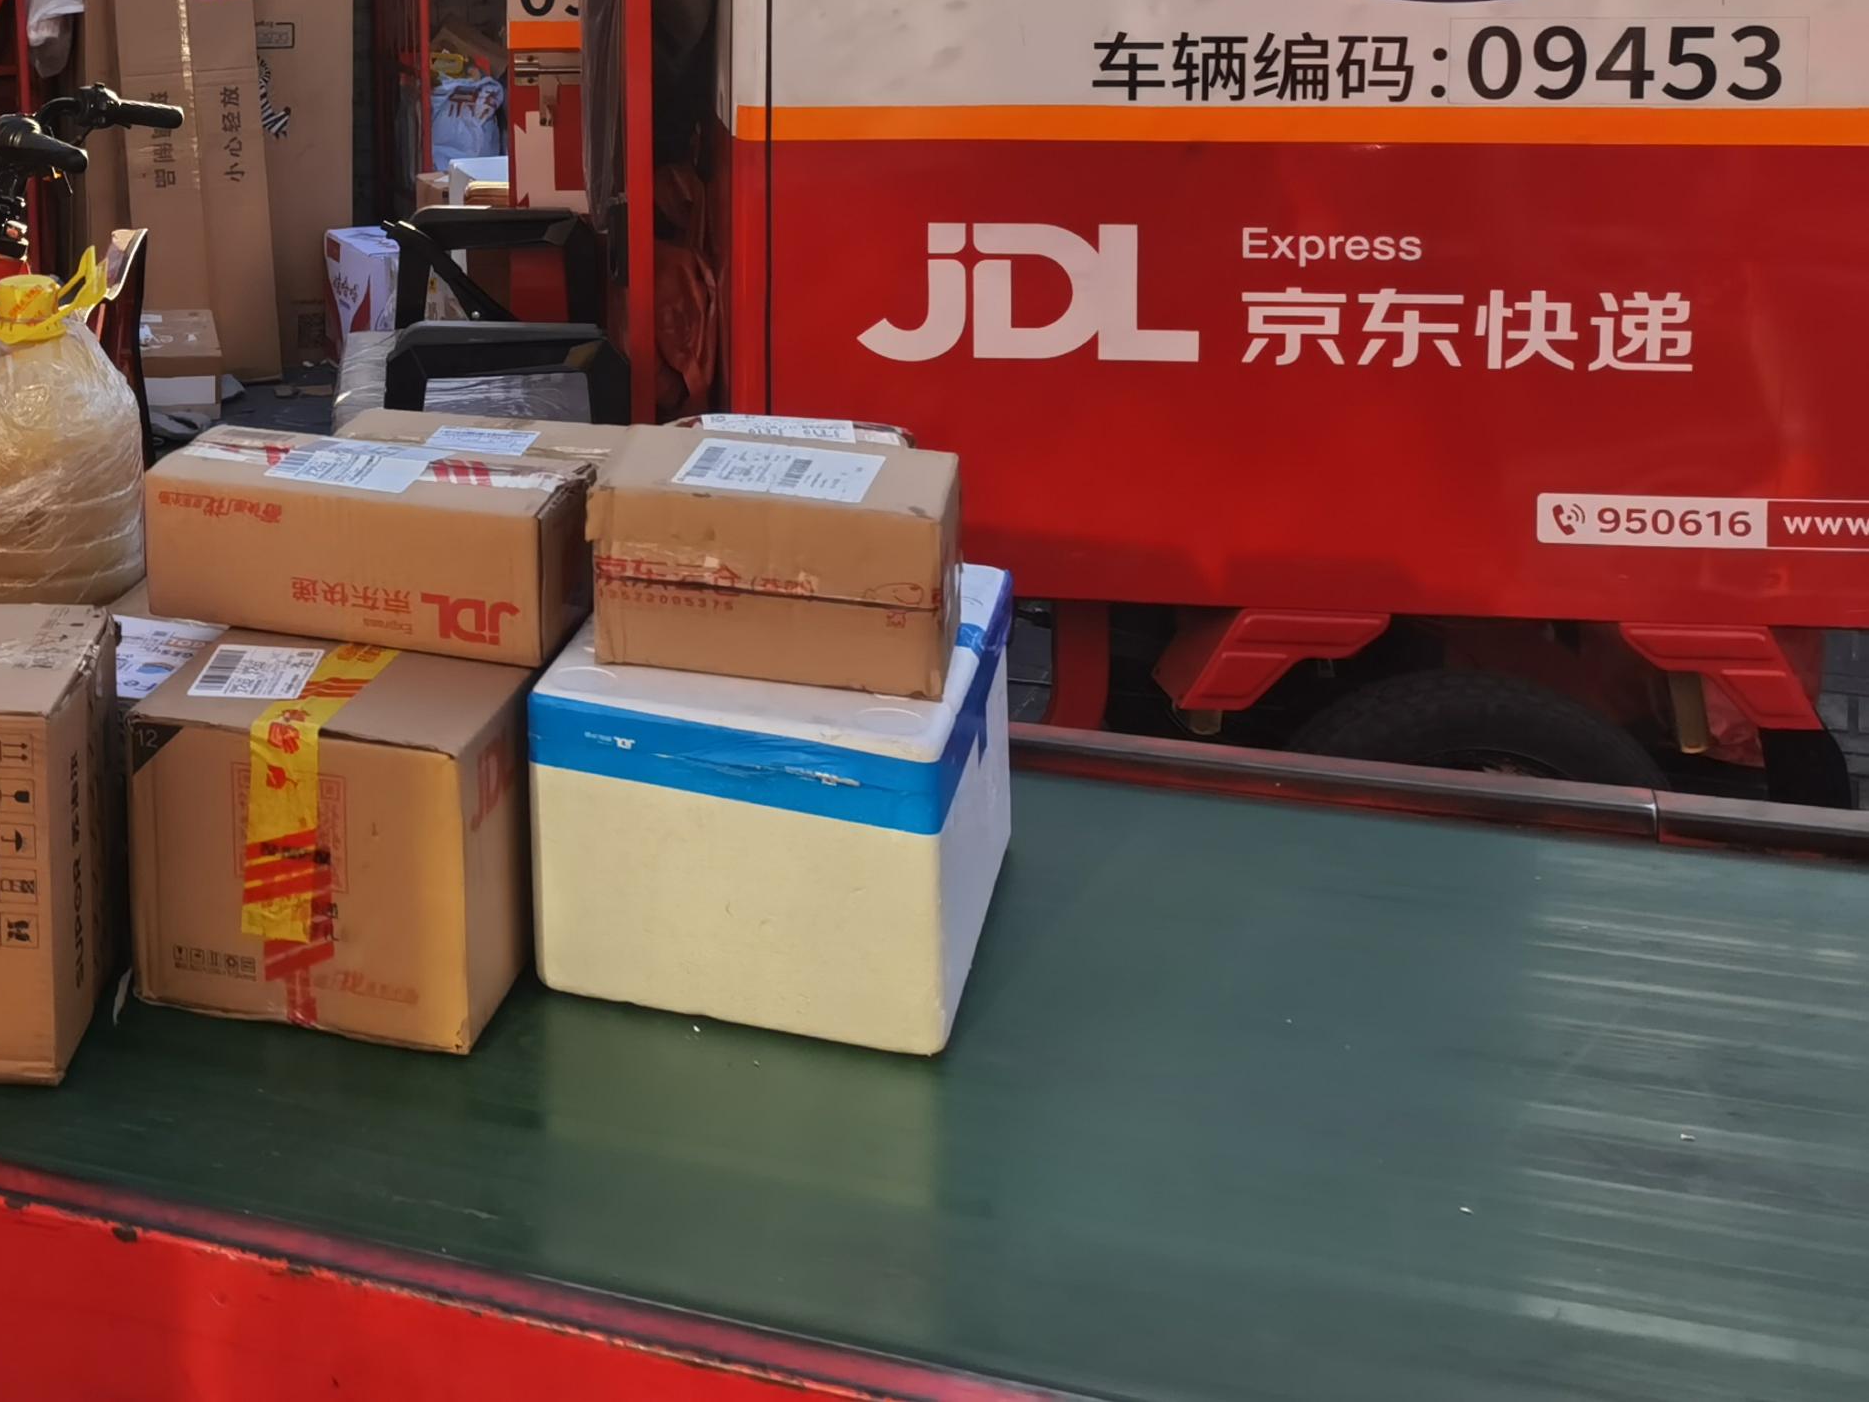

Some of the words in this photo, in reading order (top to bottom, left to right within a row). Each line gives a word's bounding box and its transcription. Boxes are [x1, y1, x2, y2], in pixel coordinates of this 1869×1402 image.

[220, 85, 243, 183] 小心轻放
[1240, 225, 1423, 268] Express
[856, 221, 1200, 363] JDL
[1240, 287, 1694, 374] 京东快递
[1594, 506, 1754, 539] 950616
[291, 576, 412, 614] 京东快递
[420, 591, 521, 647] JDL
[71, 854, 85, 989] SUPOR
